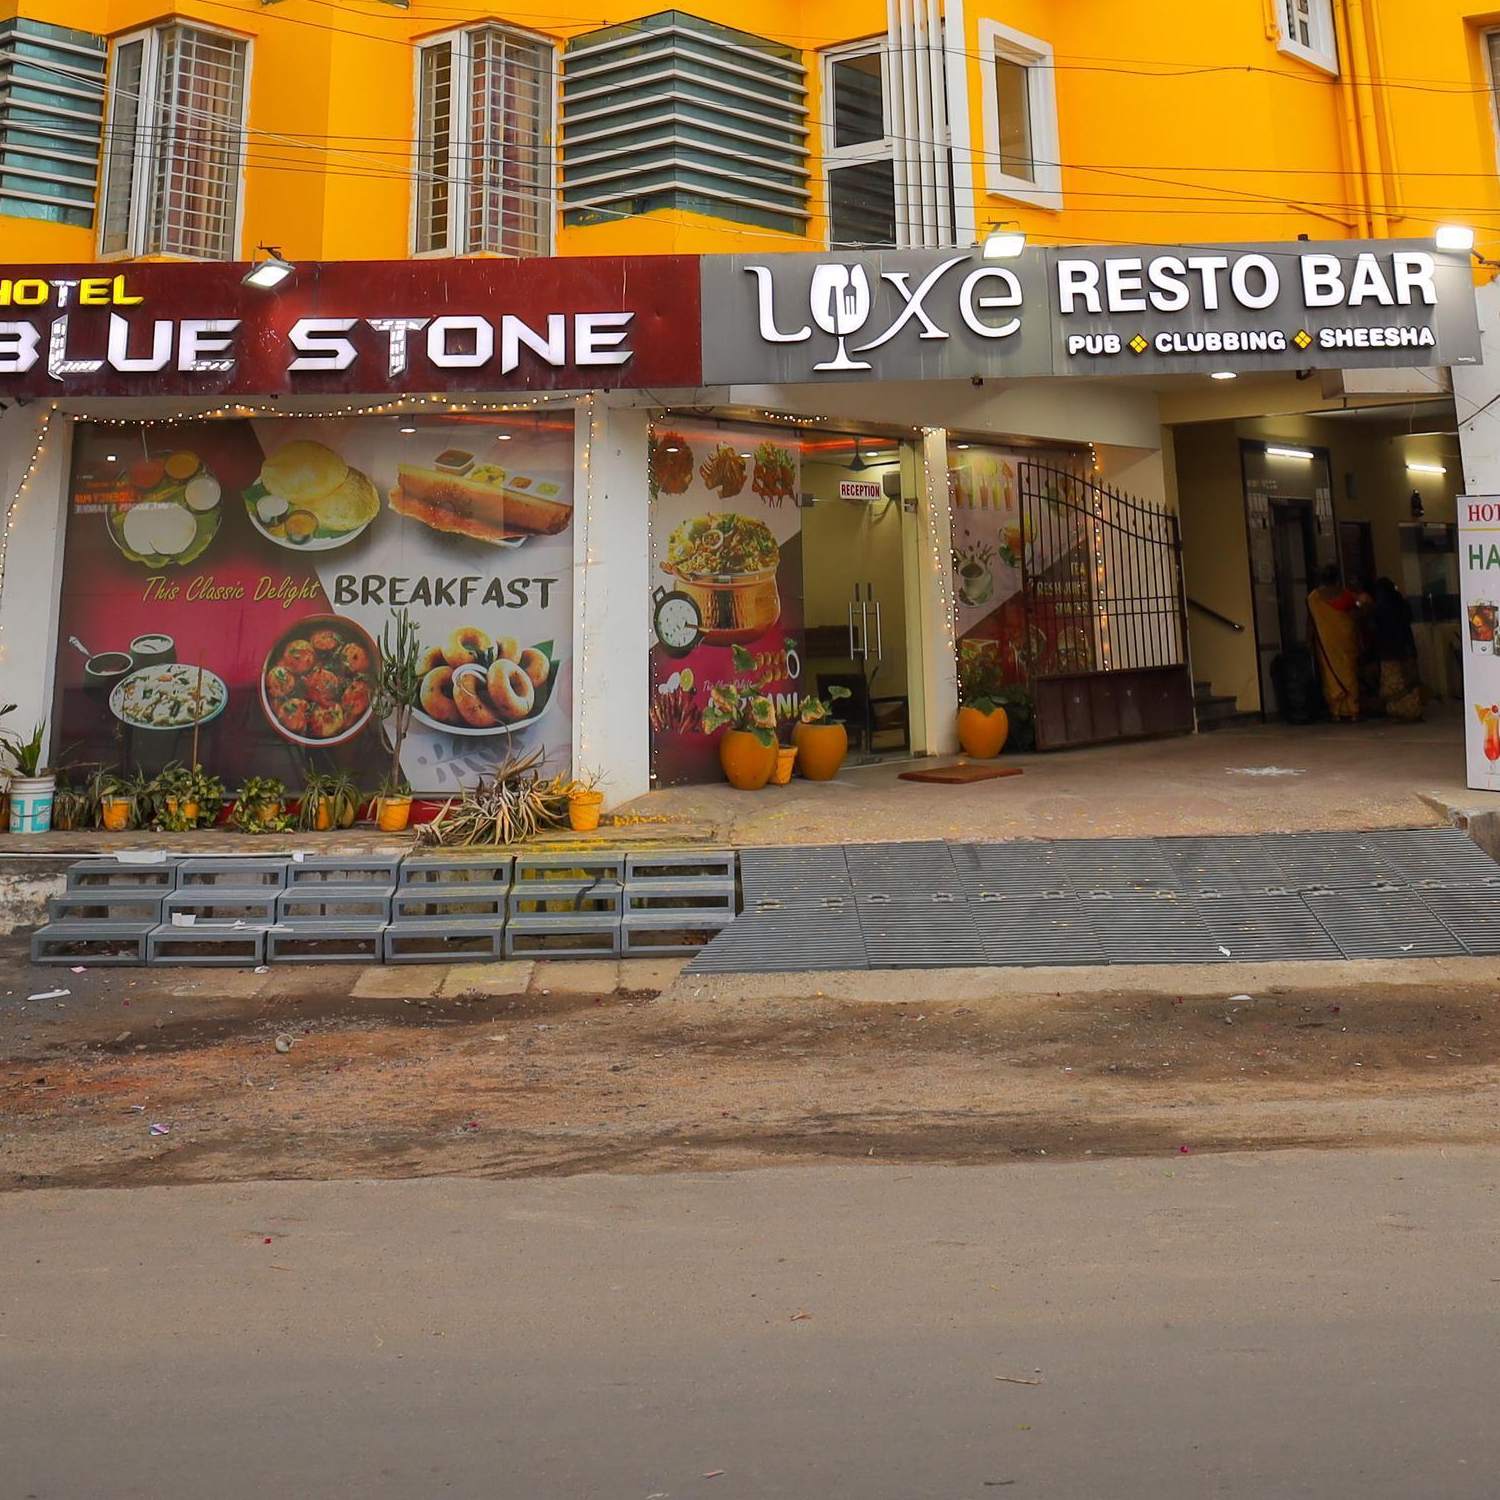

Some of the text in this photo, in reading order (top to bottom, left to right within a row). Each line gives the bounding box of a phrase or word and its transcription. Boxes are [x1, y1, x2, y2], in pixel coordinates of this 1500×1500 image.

[1057, 251, 1439, 313] RESTO BAR
[287, 311, 635, 379] STONE
[1068, 326, 1436, 356] PUB CLUBBING SHEESHA
[841, 484, 880, 497] RECEPTION
[142, 575, 321, 609] This Classic Delight
[333, 573, 560, 610] BREAKFAST
